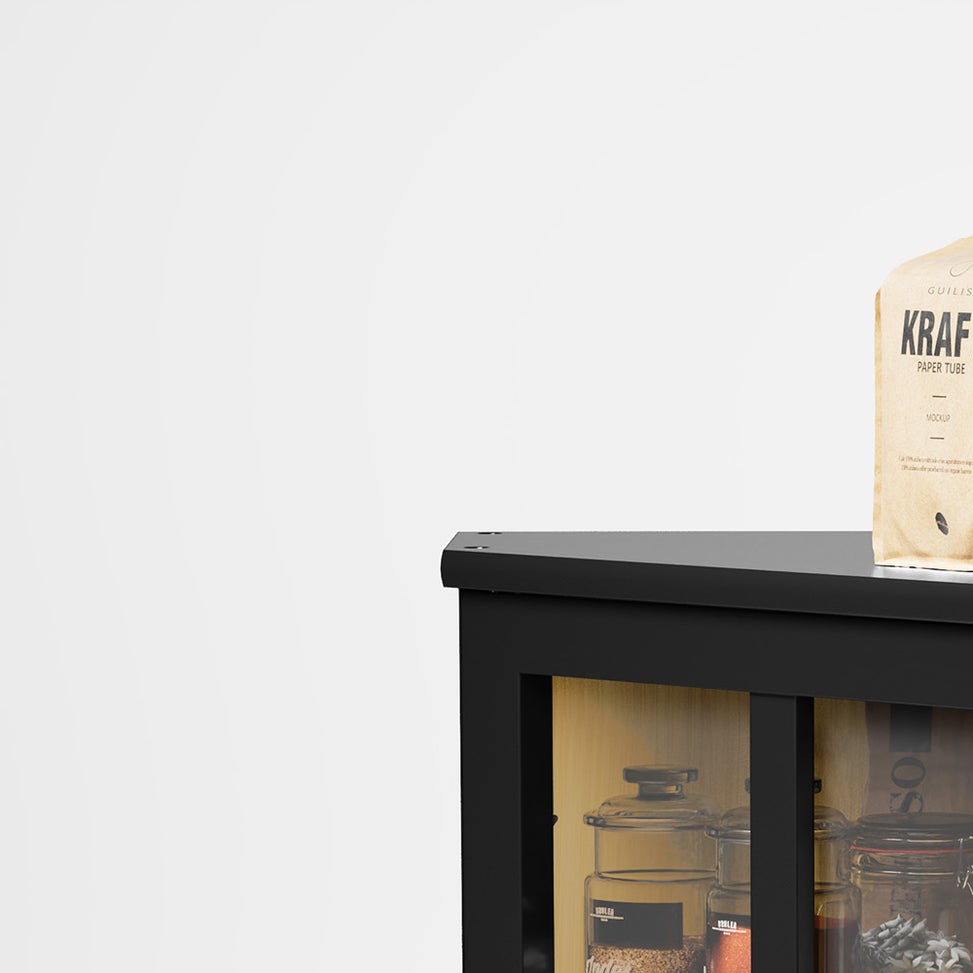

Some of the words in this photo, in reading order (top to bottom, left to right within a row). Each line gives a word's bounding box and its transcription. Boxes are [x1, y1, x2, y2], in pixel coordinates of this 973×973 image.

[927, 286, 973, 297] GUILIS
[917, 361, 943, 374] PAPER
[944, 362, 966, 375] TUBE
